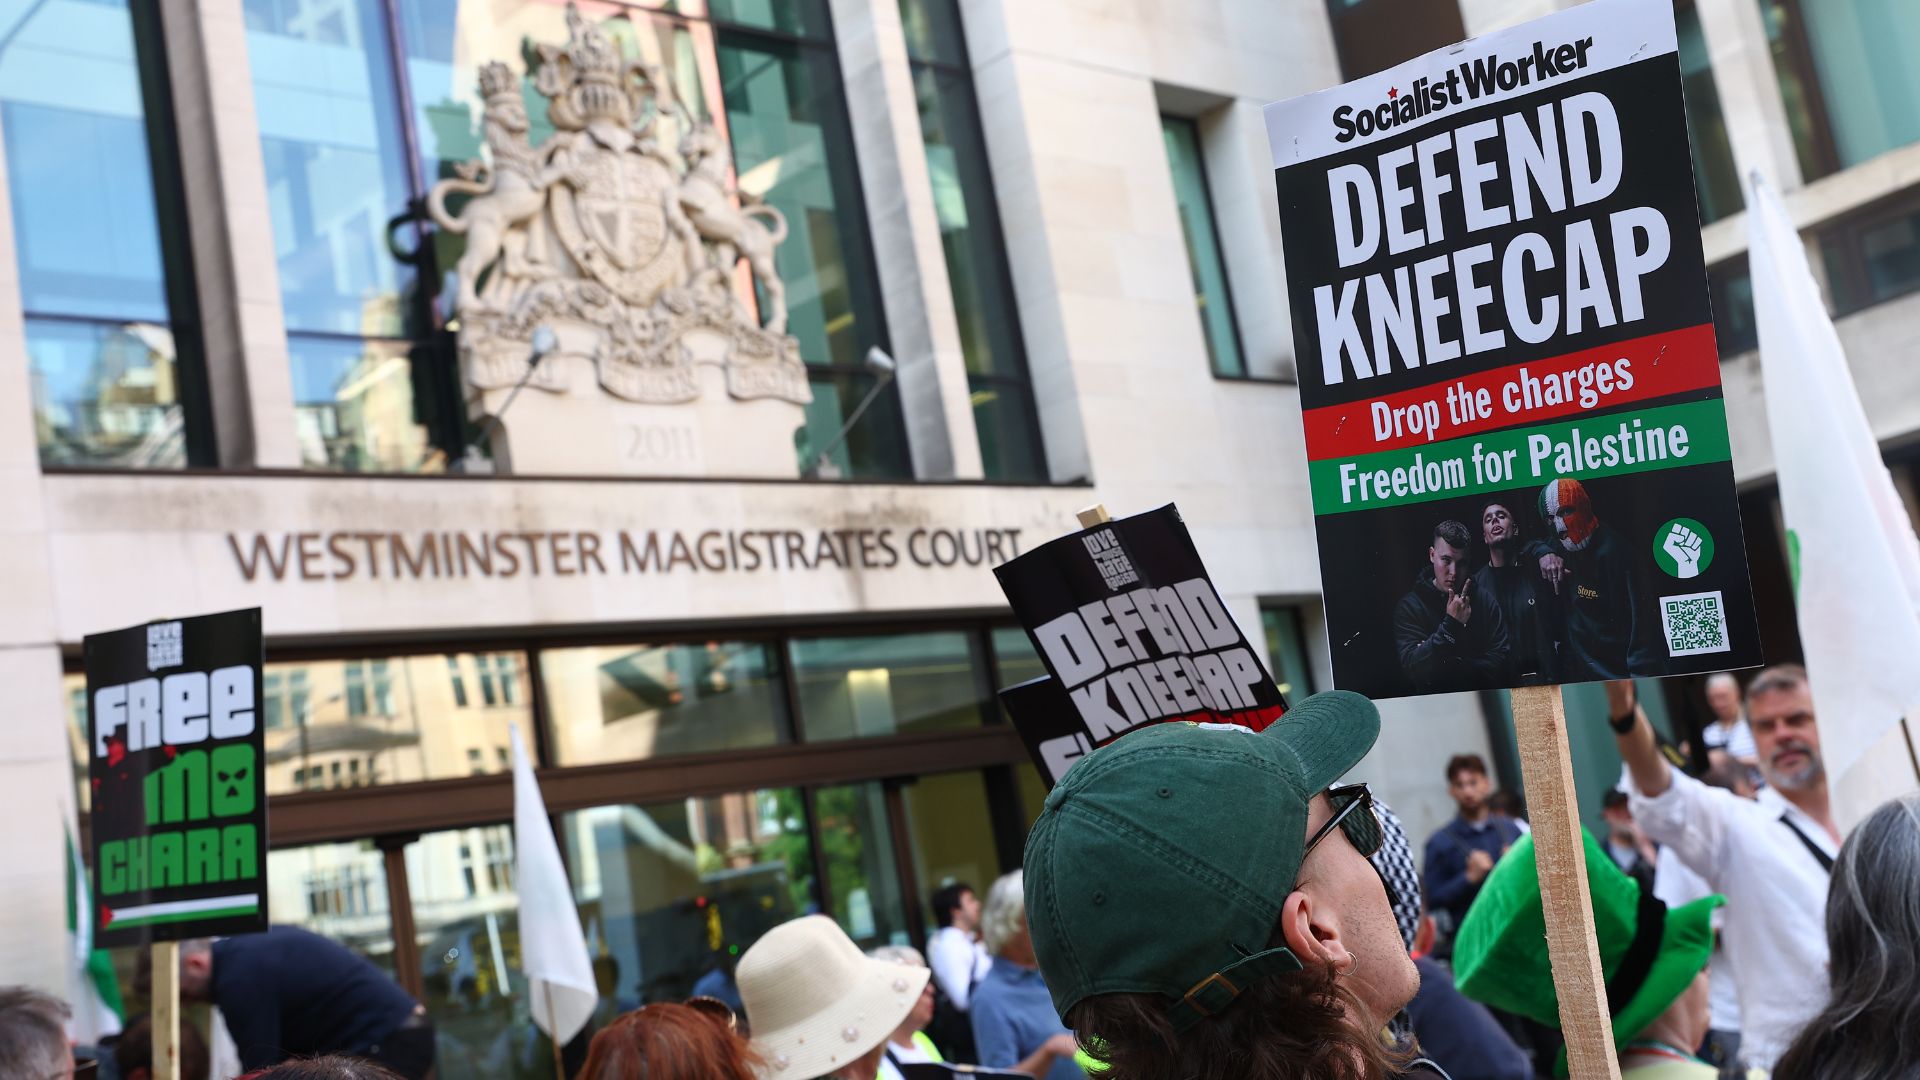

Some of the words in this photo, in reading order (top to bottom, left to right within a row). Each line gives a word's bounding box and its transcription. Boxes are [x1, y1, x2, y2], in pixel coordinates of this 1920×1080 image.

[1332, 69, 1463, 143] Socialist
[1459, 36, 1593, 100] Worker
[1327, 91, 1623, 268] DEFEND
[1313, 206, 1672, 385] KNEECAP
[628, 424, 695, 463] 2011
[1370, 400, 1441, 441] Drop
[1446, 381, 1492, 426] the
[1502, 357, 1634, 408] charges
[1339, 453, 1466, 504] Freedom
[1472, 442, 1517, 485] for
[1528, 418, 1690, 477] Palestine
[227, 531, 607, 582] WESTMINSTER
[618, 528, 898, 573] MAGISTRATES
[907, 528, 1022, 568] COURT
[1033, 577, 1240, 689] DEFEND
[1069, 647, 1262, 742] KNEECAP
[100, 823, 257, 896] CHARA
